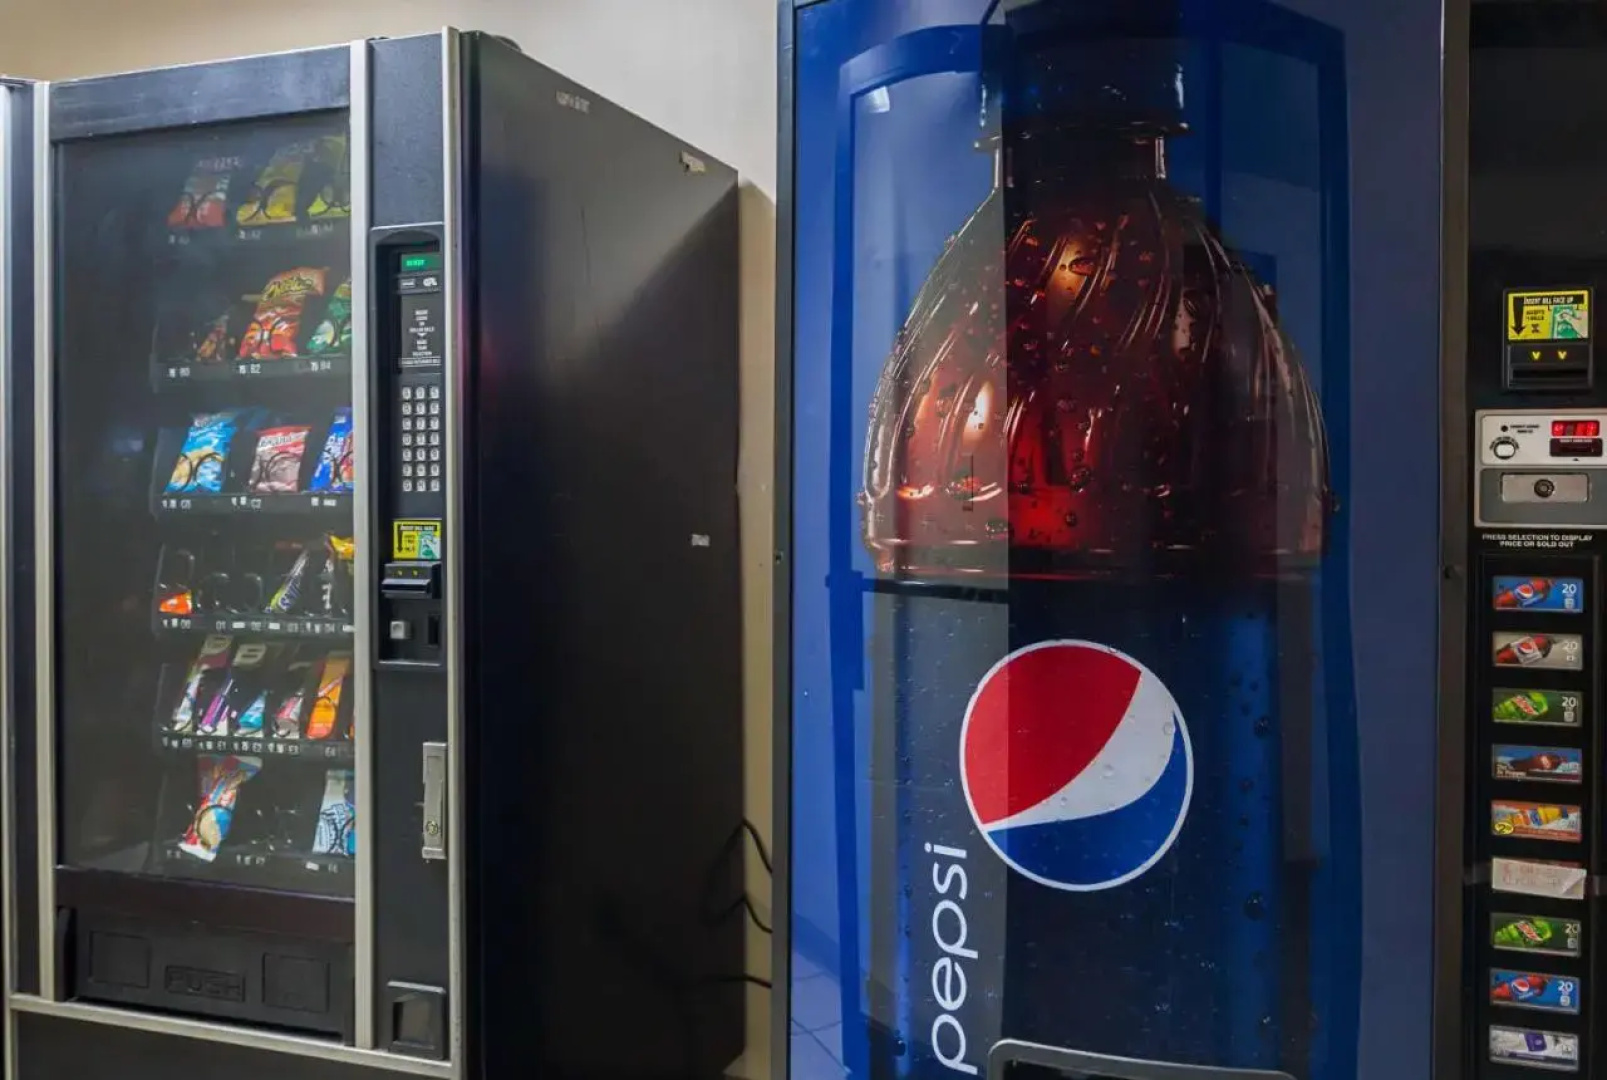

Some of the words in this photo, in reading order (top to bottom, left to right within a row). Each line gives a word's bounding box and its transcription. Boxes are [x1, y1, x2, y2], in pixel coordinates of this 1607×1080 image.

[1561, 534, 1593, 542] DISPLAY
[1500, 540, 1522, 548] PRICE
[1523, 540, 1535, 548] OR
[1536, 540, 1557, 548] SOLD
[1558, 540, 1574, 548] OUT
[1562, 583, 1577, 594] 20
[1562, 641, 1578, 651] 20
[1562, 696, 1577, 707] 20
[1565, 923, 1579, 934] 20
[924, 841, 979, 1076] pepsi
[168, 969, 241, 997] PUSH
[1558, 980, 1573, 992] 20
